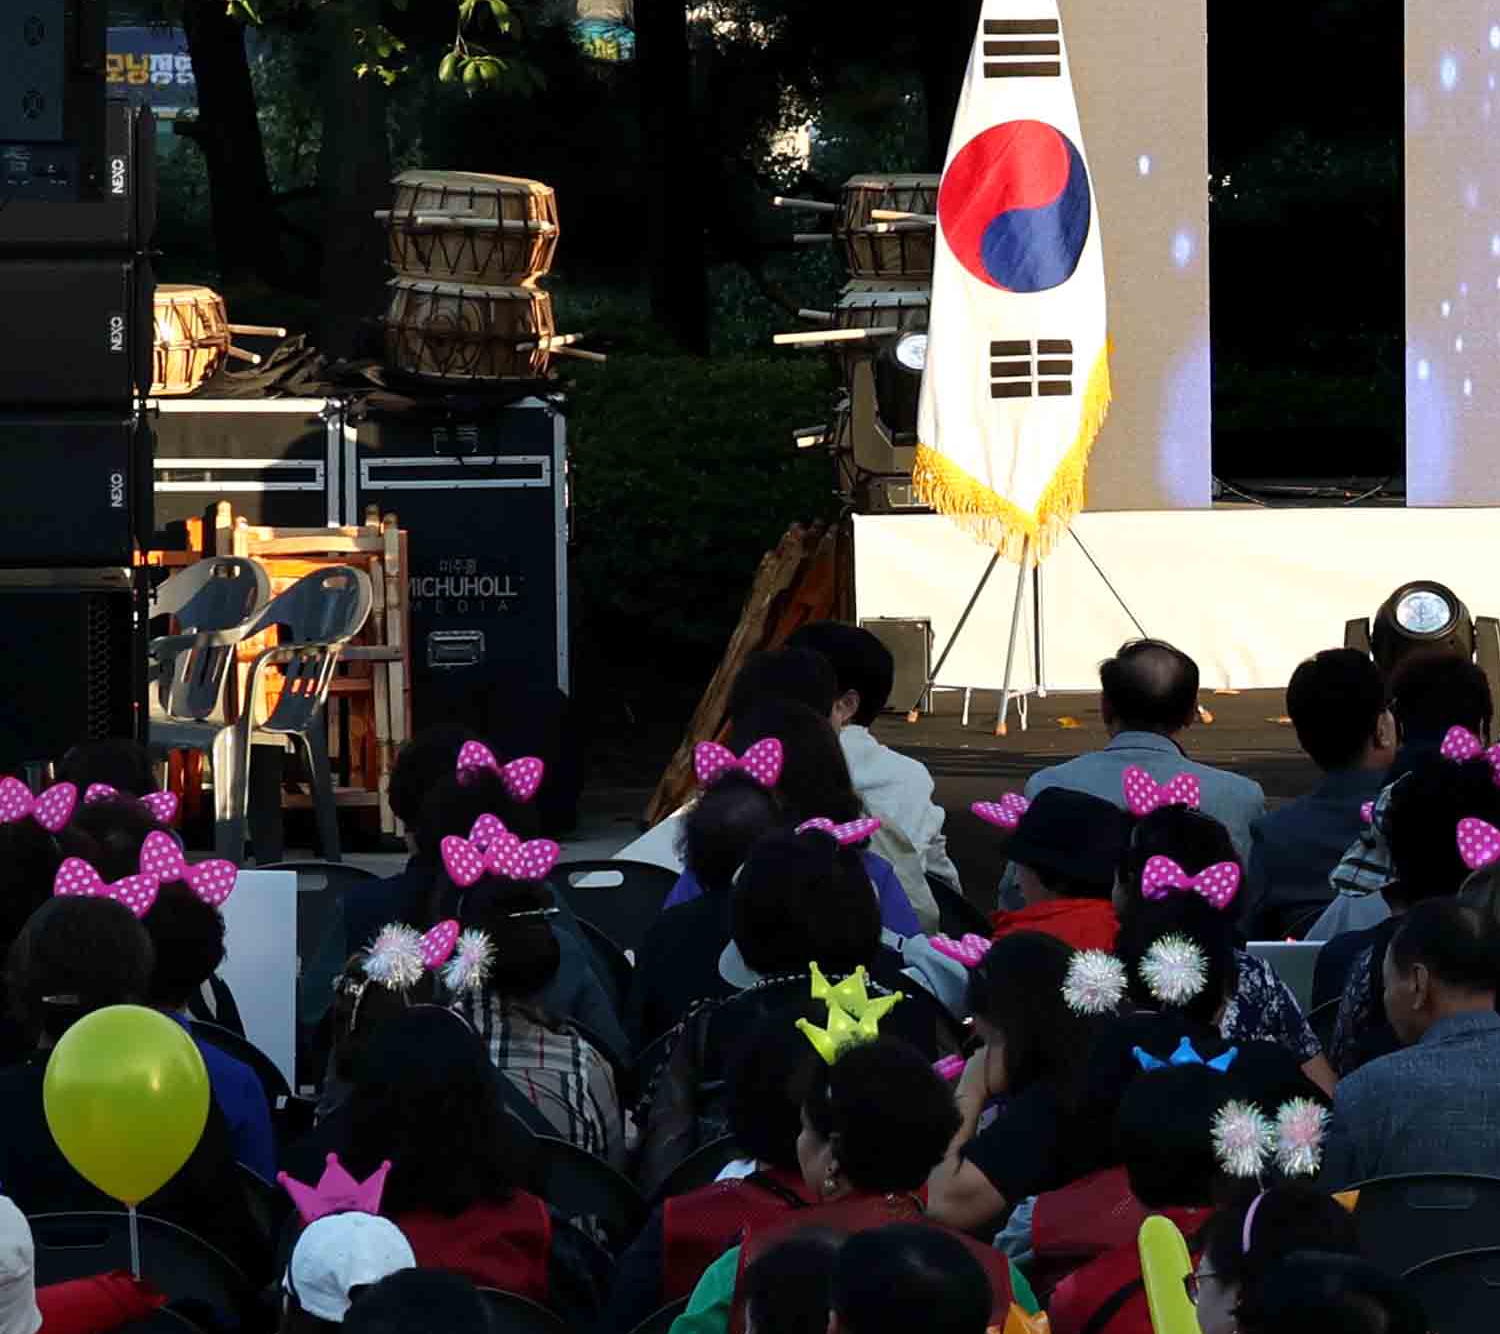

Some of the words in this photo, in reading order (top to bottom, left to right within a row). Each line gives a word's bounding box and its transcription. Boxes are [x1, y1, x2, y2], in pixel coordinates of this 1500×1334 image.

[111, 158, 124, 194] NEXO
[110, 316, 123, 351] NEXO
[110, 472, 123, 507] NEXO
